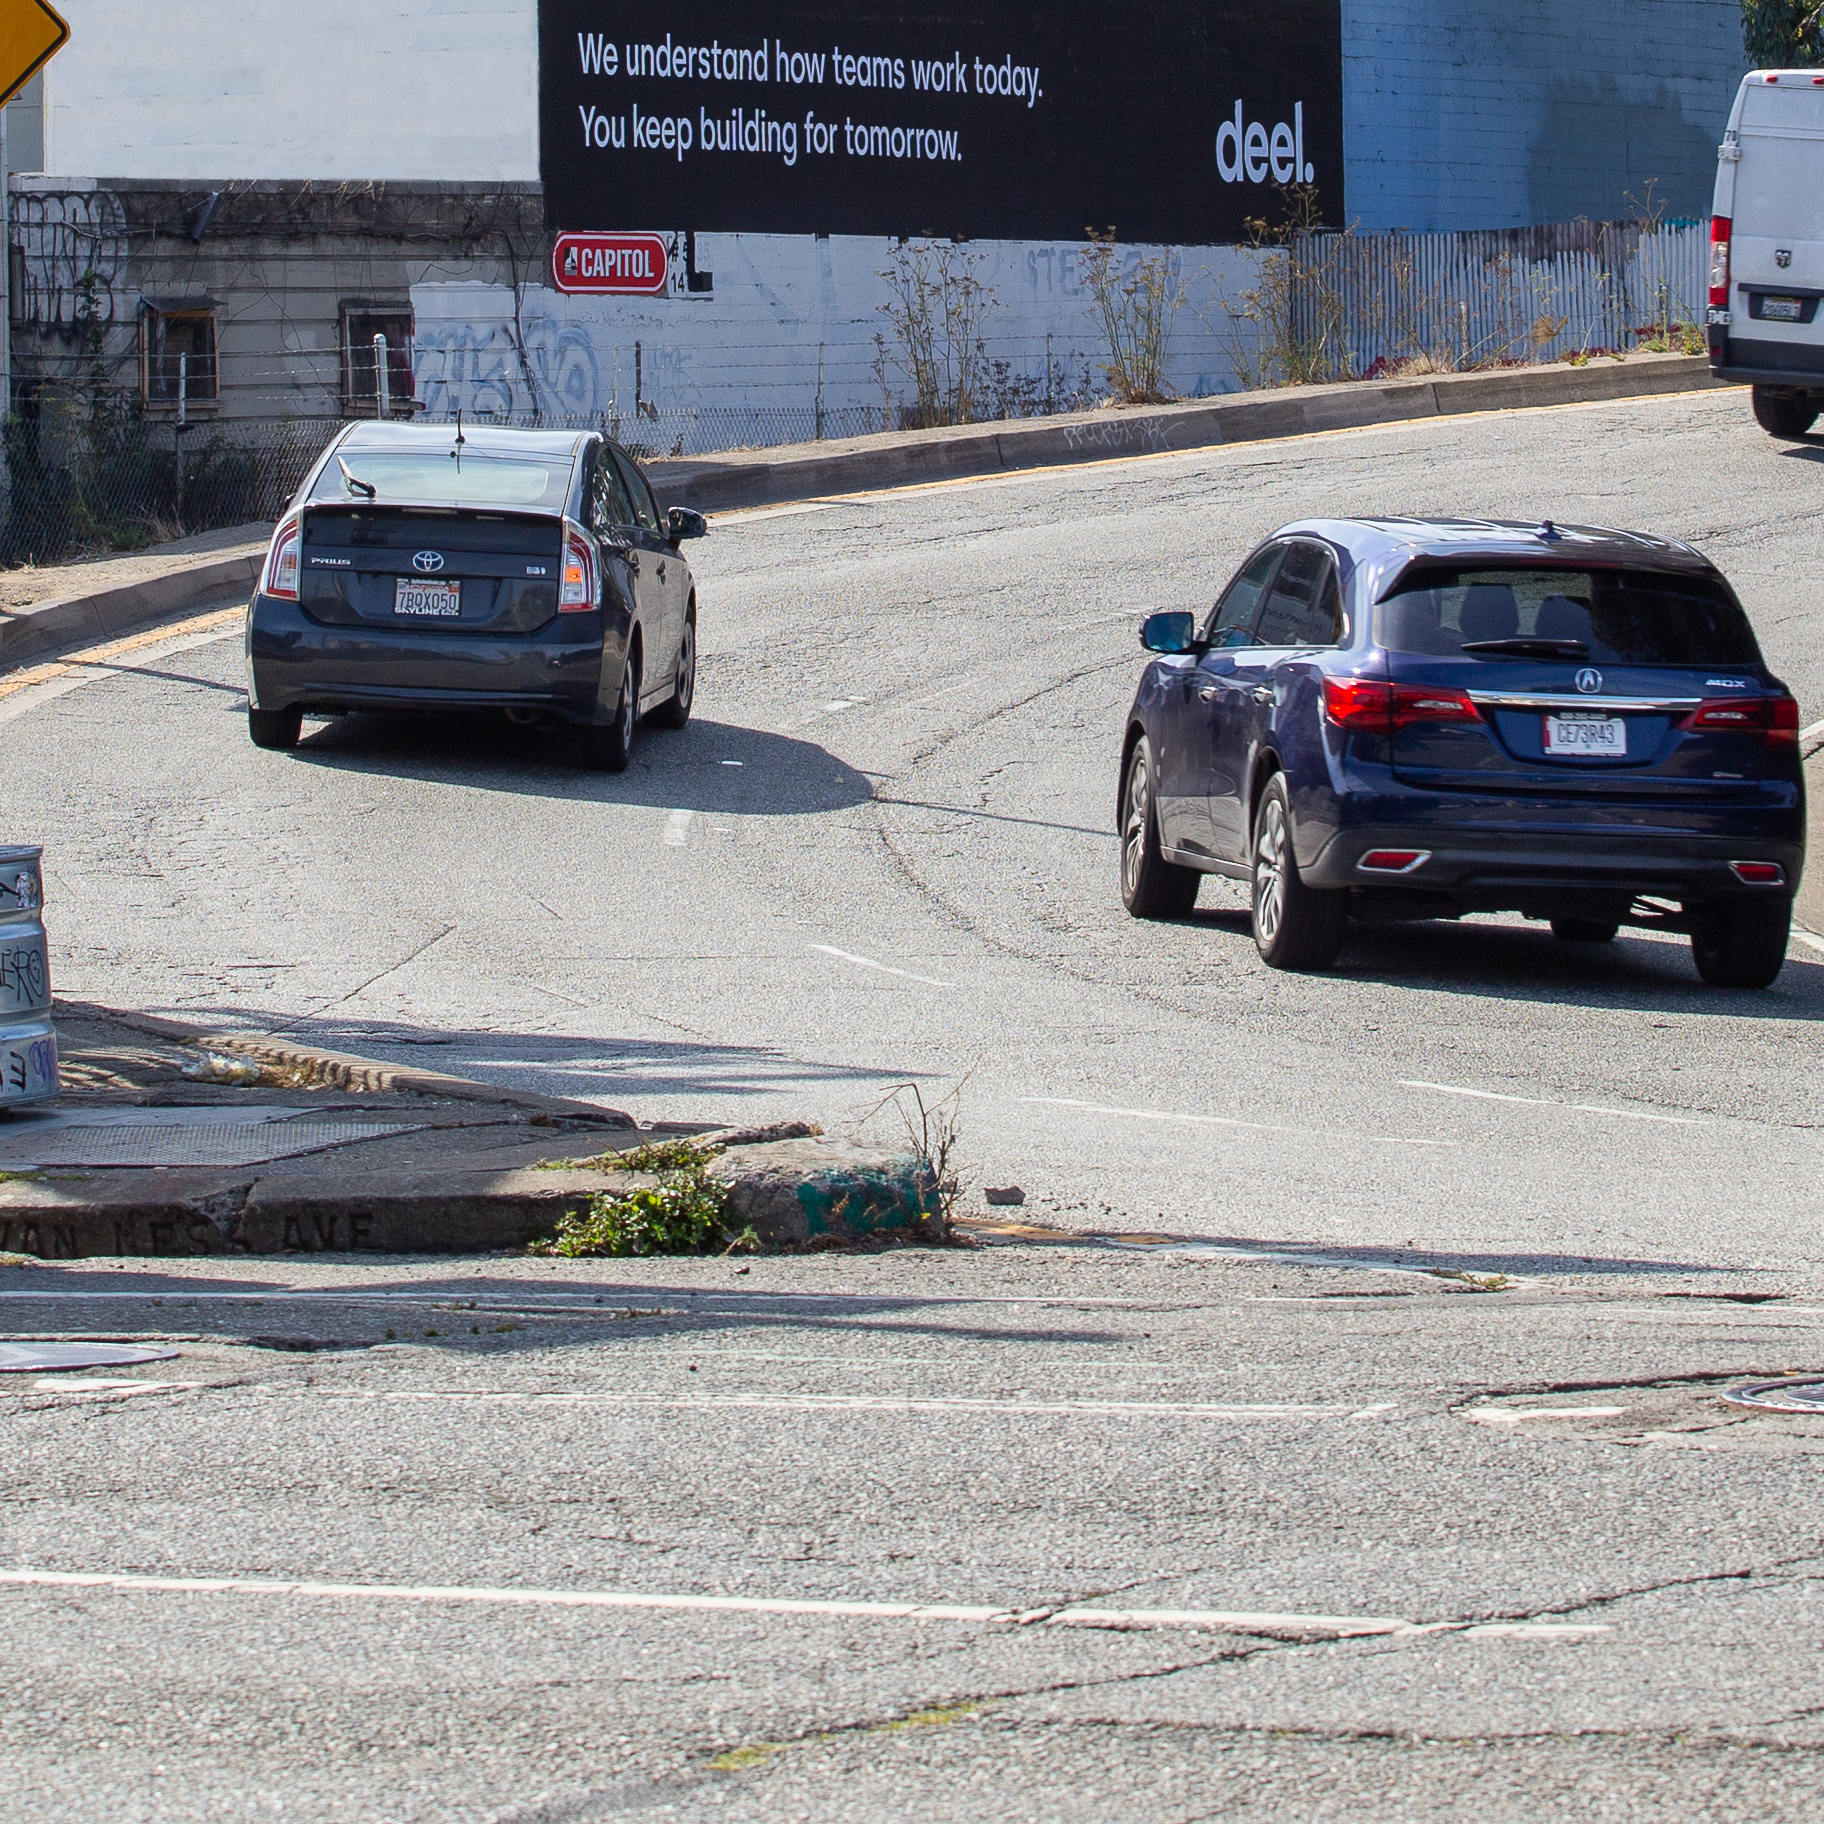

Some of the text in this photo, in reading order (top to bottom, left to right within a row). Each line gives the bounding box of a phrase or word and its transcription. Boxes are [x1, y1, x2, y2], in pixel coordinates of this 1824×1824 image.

[578, 32, 1044, 108] We understand how teams work today.
[579, 105, 962, 166] You keep building for tomorrow.
[1216, 98, 1315, 184] deel.
[581, 248, 655, 278] CAPITOL
[284, 1213, 376, 1253] AVE
